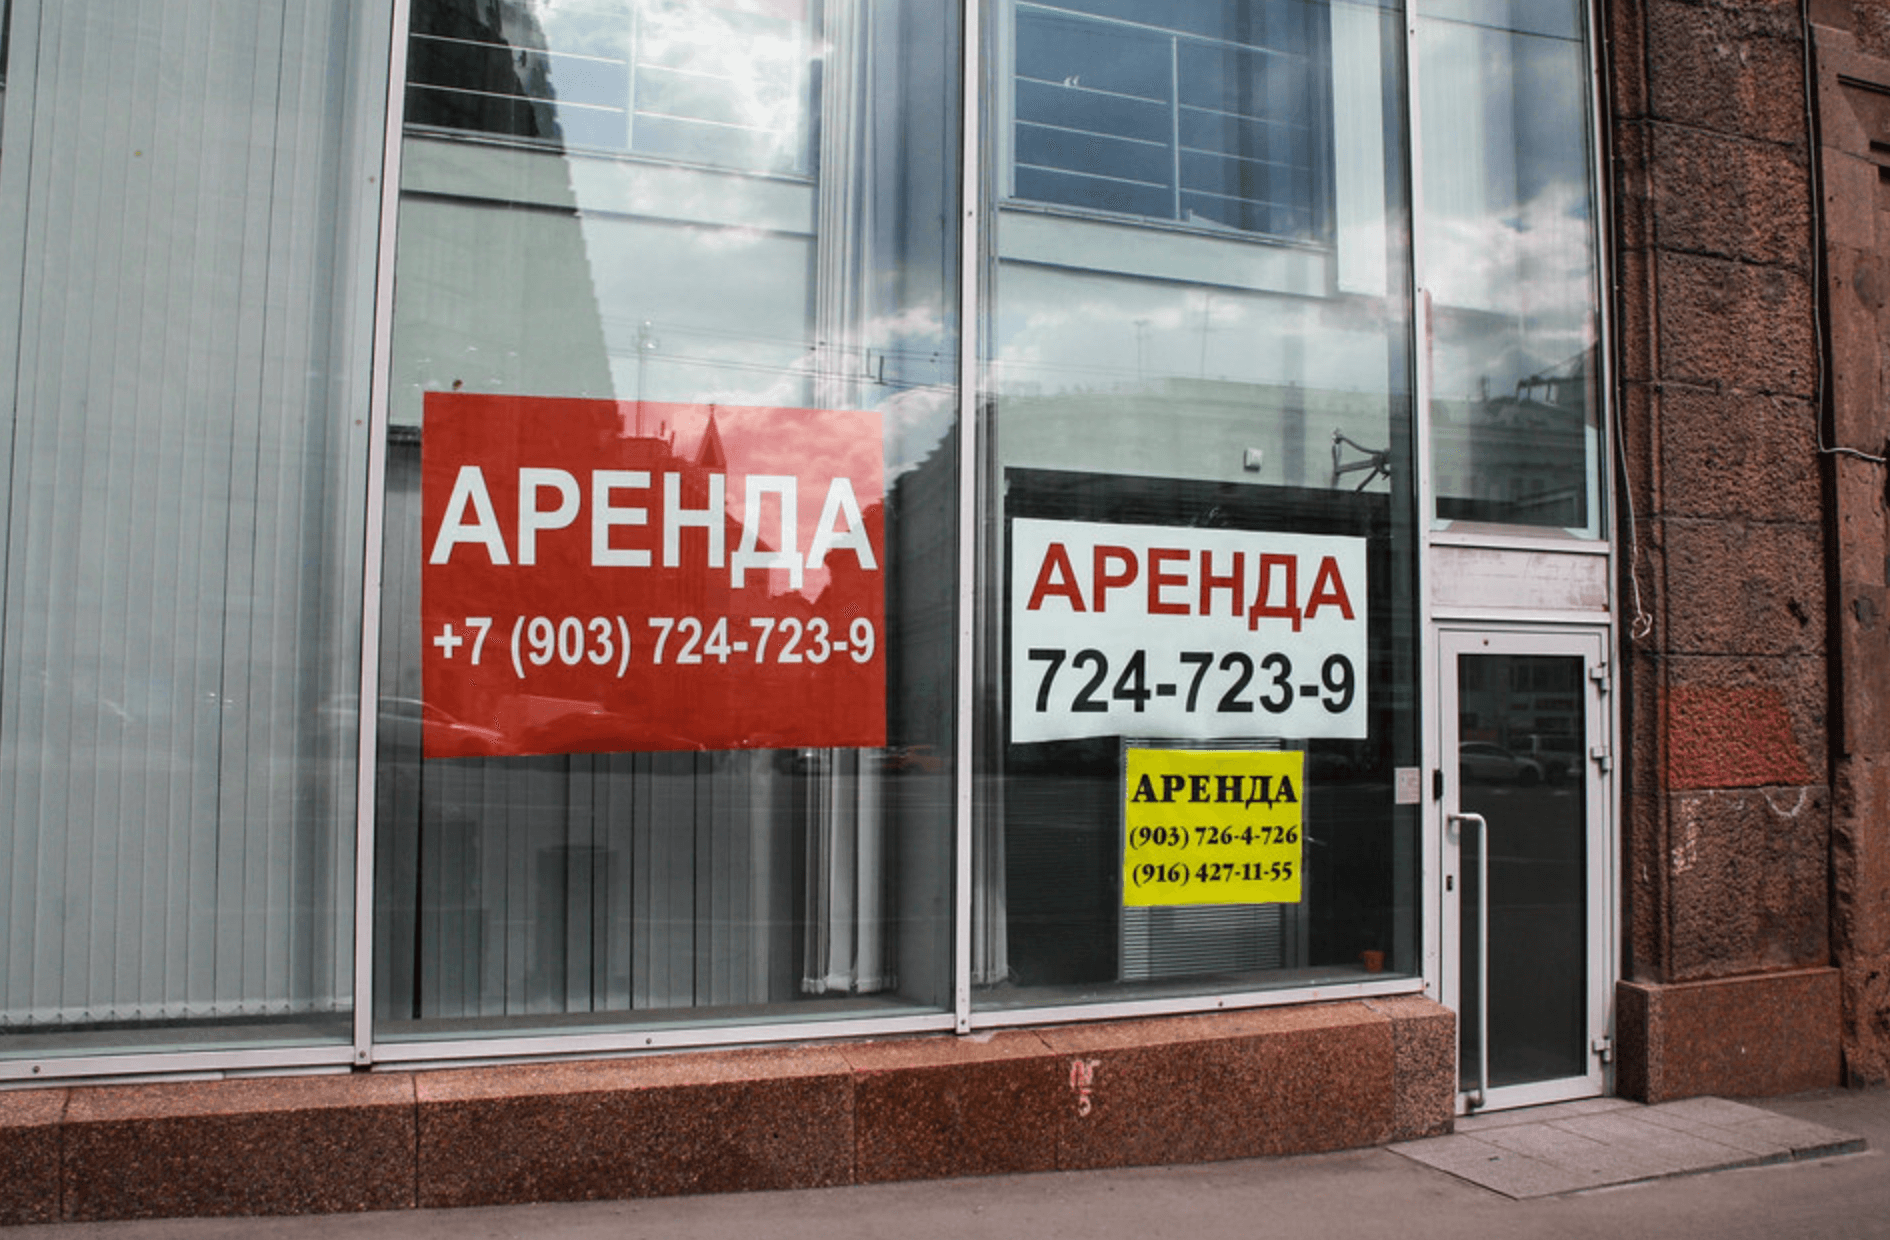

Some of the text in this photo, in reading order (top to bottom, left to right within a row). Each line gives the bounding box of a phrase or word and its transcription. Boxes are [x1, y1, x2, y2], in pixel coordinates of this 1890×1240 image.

[429, 465, 878, 589] АРЕНДА
[1026, 542, 1355, 632] АРЕНДА
[433, 615, 875, 678] +7 (903) 724-723-9
[1028, 648, 1355, 714] 724-723-9
[1130, 773, 1298, 810] АРЕНДА
[1129, 824, 1298, 850] (903) 726-4-726
[1133, 861, 1293, 887] (916) 427-11-55
